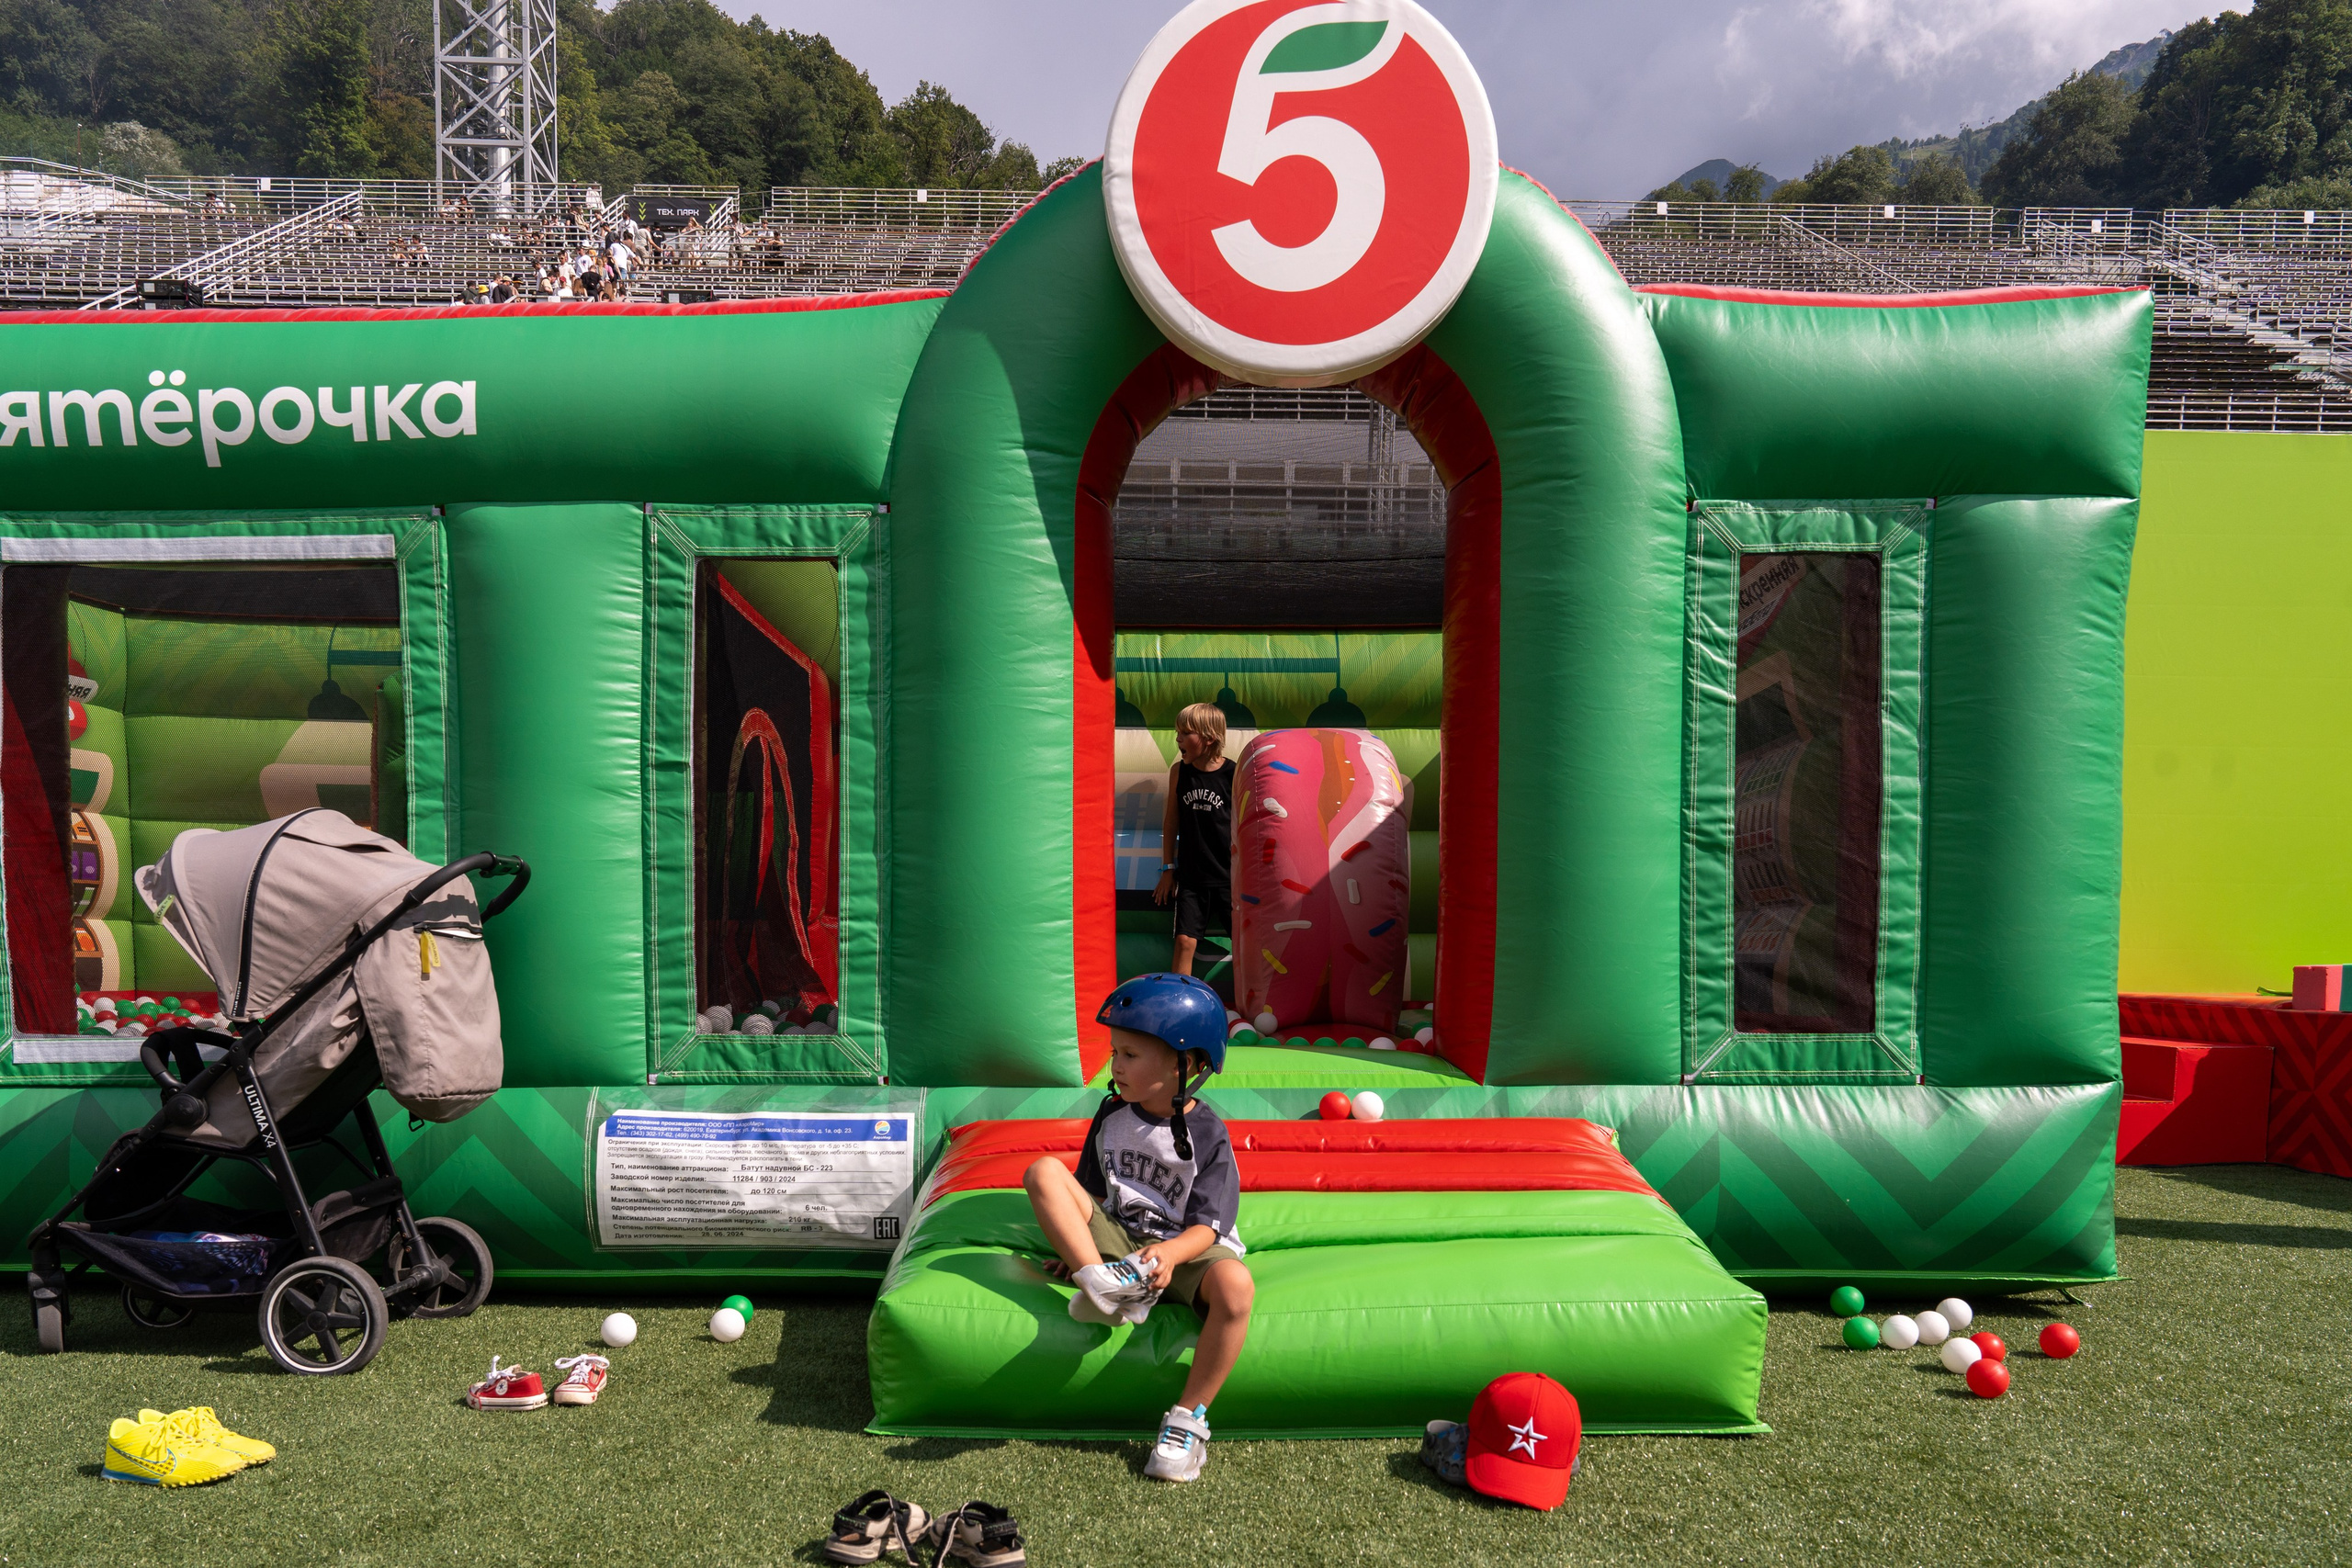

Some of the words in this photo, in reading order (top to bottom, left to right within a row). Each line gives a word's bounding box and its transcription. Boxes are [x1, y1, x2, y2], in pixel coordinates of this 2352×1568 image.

[1211, 3, 1405, 292] 5
[656, 208, 674, 216] ТЕХ.
[676, 209, 699, 217] ПАРК
[1182, 788, 1224, 809] CONVERSE
[243, 1084, 269, 1132] ULTIMA
[262, 1132, 277, 1148] X4
[617, 1118, 660, 1126] Наименование
[661, 1120, 707, 1128] производителя:
[610, 1173, 649, 1181] Заводской
[610, 1196, 660, 1204] Максимально
[684, 1198, 730, 1206] посетителей
[611, 1204, 673, 1213] одновременного
[728, 1207, 783, 1216] оборудовании:
[876, 1219, 899, 1238] EAC
